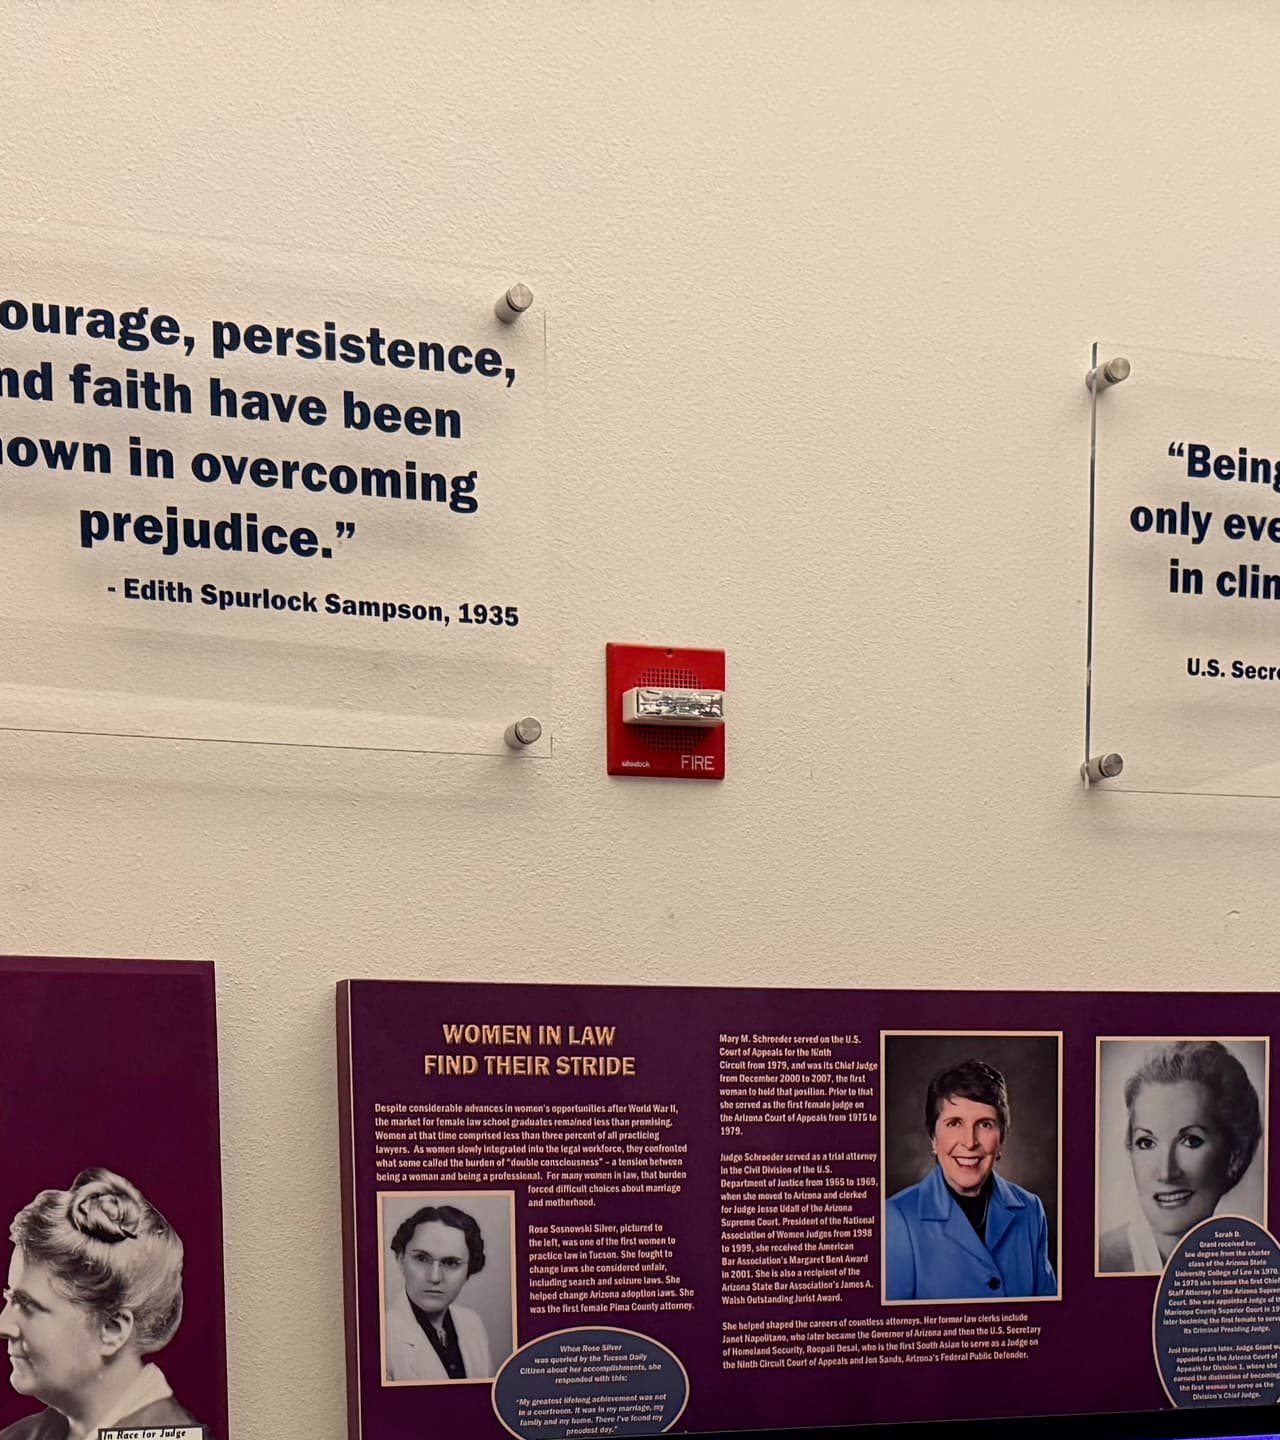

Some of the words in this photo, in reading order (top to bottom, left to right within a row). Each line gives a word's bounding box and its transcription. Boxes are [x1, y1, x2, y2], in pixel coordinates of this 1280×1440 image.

[212, 320, 515, 388] persistence,
[68, 363, 192, 414] faith
[209, 377, 327, 426] have
[343, 390, 461, 439] been
[129, 435, 174, 479] in
[191, 452, 478, 514] overcoming
[79, 506, 355, 559] prejudice.”
[1130, 501, 1212, 545] only
[1169, 558, 1203, 595] in
[124, 577, 192, 603] Edith
[200, 583, 318, 613] Spurlock
[324, 593, 449, 627] Sampson,
[458, 602, 519, 627] 1935
[1187, 657, 1225, 677] U.S.
[681, 755, 715, 771] FIRE
[442, 1024, 531, 1045] WOMEN
[538, 1025, 561, 1045] IN
[568, 1025, 616, 1045] LAW
[424, 1055, 478, 1075] FIND
[483, 1055, 550, 1075] THEIR
[556, 1055, 635, 1076] STRIDE
[374, 1103, 407, 1114] Despite
[408, 1103, 463, 1113] considerable
[464, 1103, 503, 1113] advances
[504, 1103, 513, 1113] in
[514, 1104, 550, 1113] women's
[551, 1103, 606, 1114] opportunities
[607, 1103, 627, 1113] after
[628, 1103, 651, 1113] World
[652, 1103, 668, 1113] War
[670, 1103, 678, 1114] II,
[159, 1428, 186, 1439] Judge
